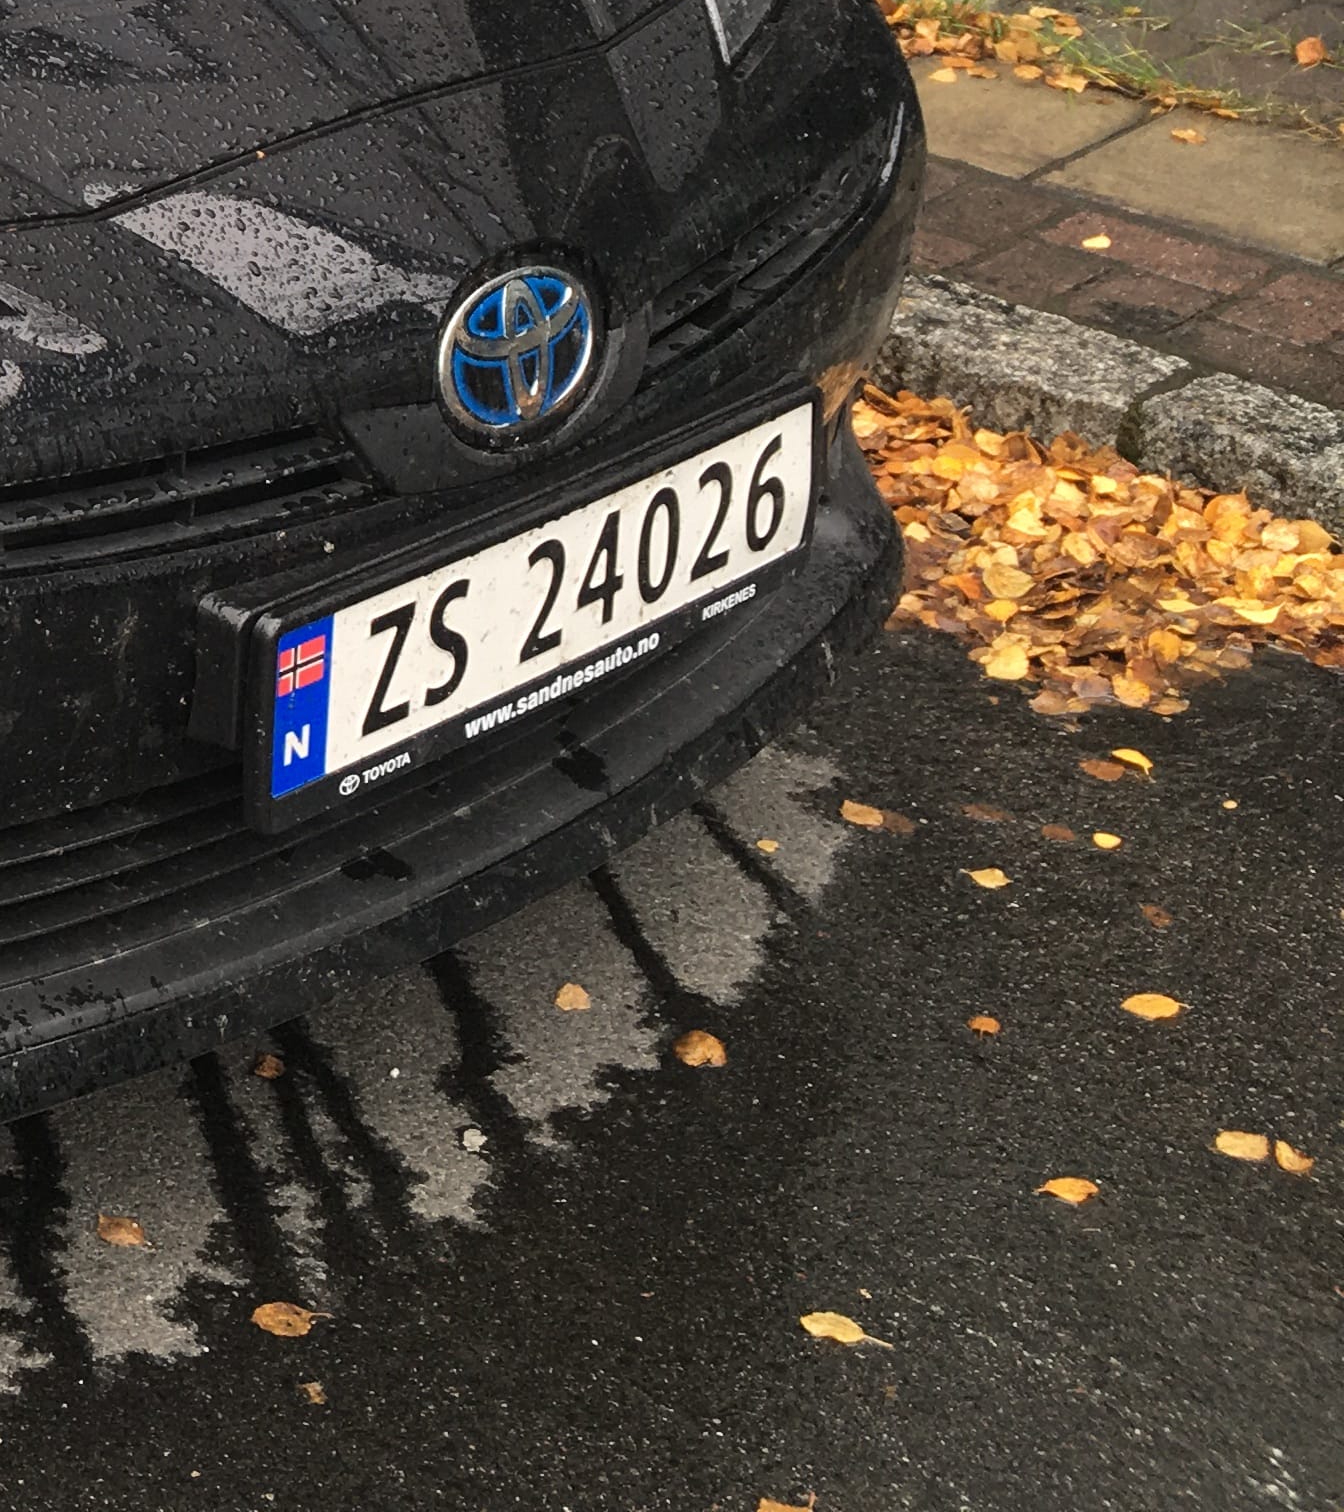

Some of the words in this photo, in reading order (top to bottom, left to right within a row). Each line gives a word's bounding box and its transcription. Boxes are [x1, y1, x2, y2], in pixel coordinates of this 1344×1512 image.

[362, 577, 470, 737] ZS
[519, 433, 785, 664] 24026
[702, 584, 757, 621] KIRKENES
[465, 632, 661, 739] www.sandnesauto.no
[283, 723, 310, 767] N
[362, 751, 412, 784] TOYOTA
